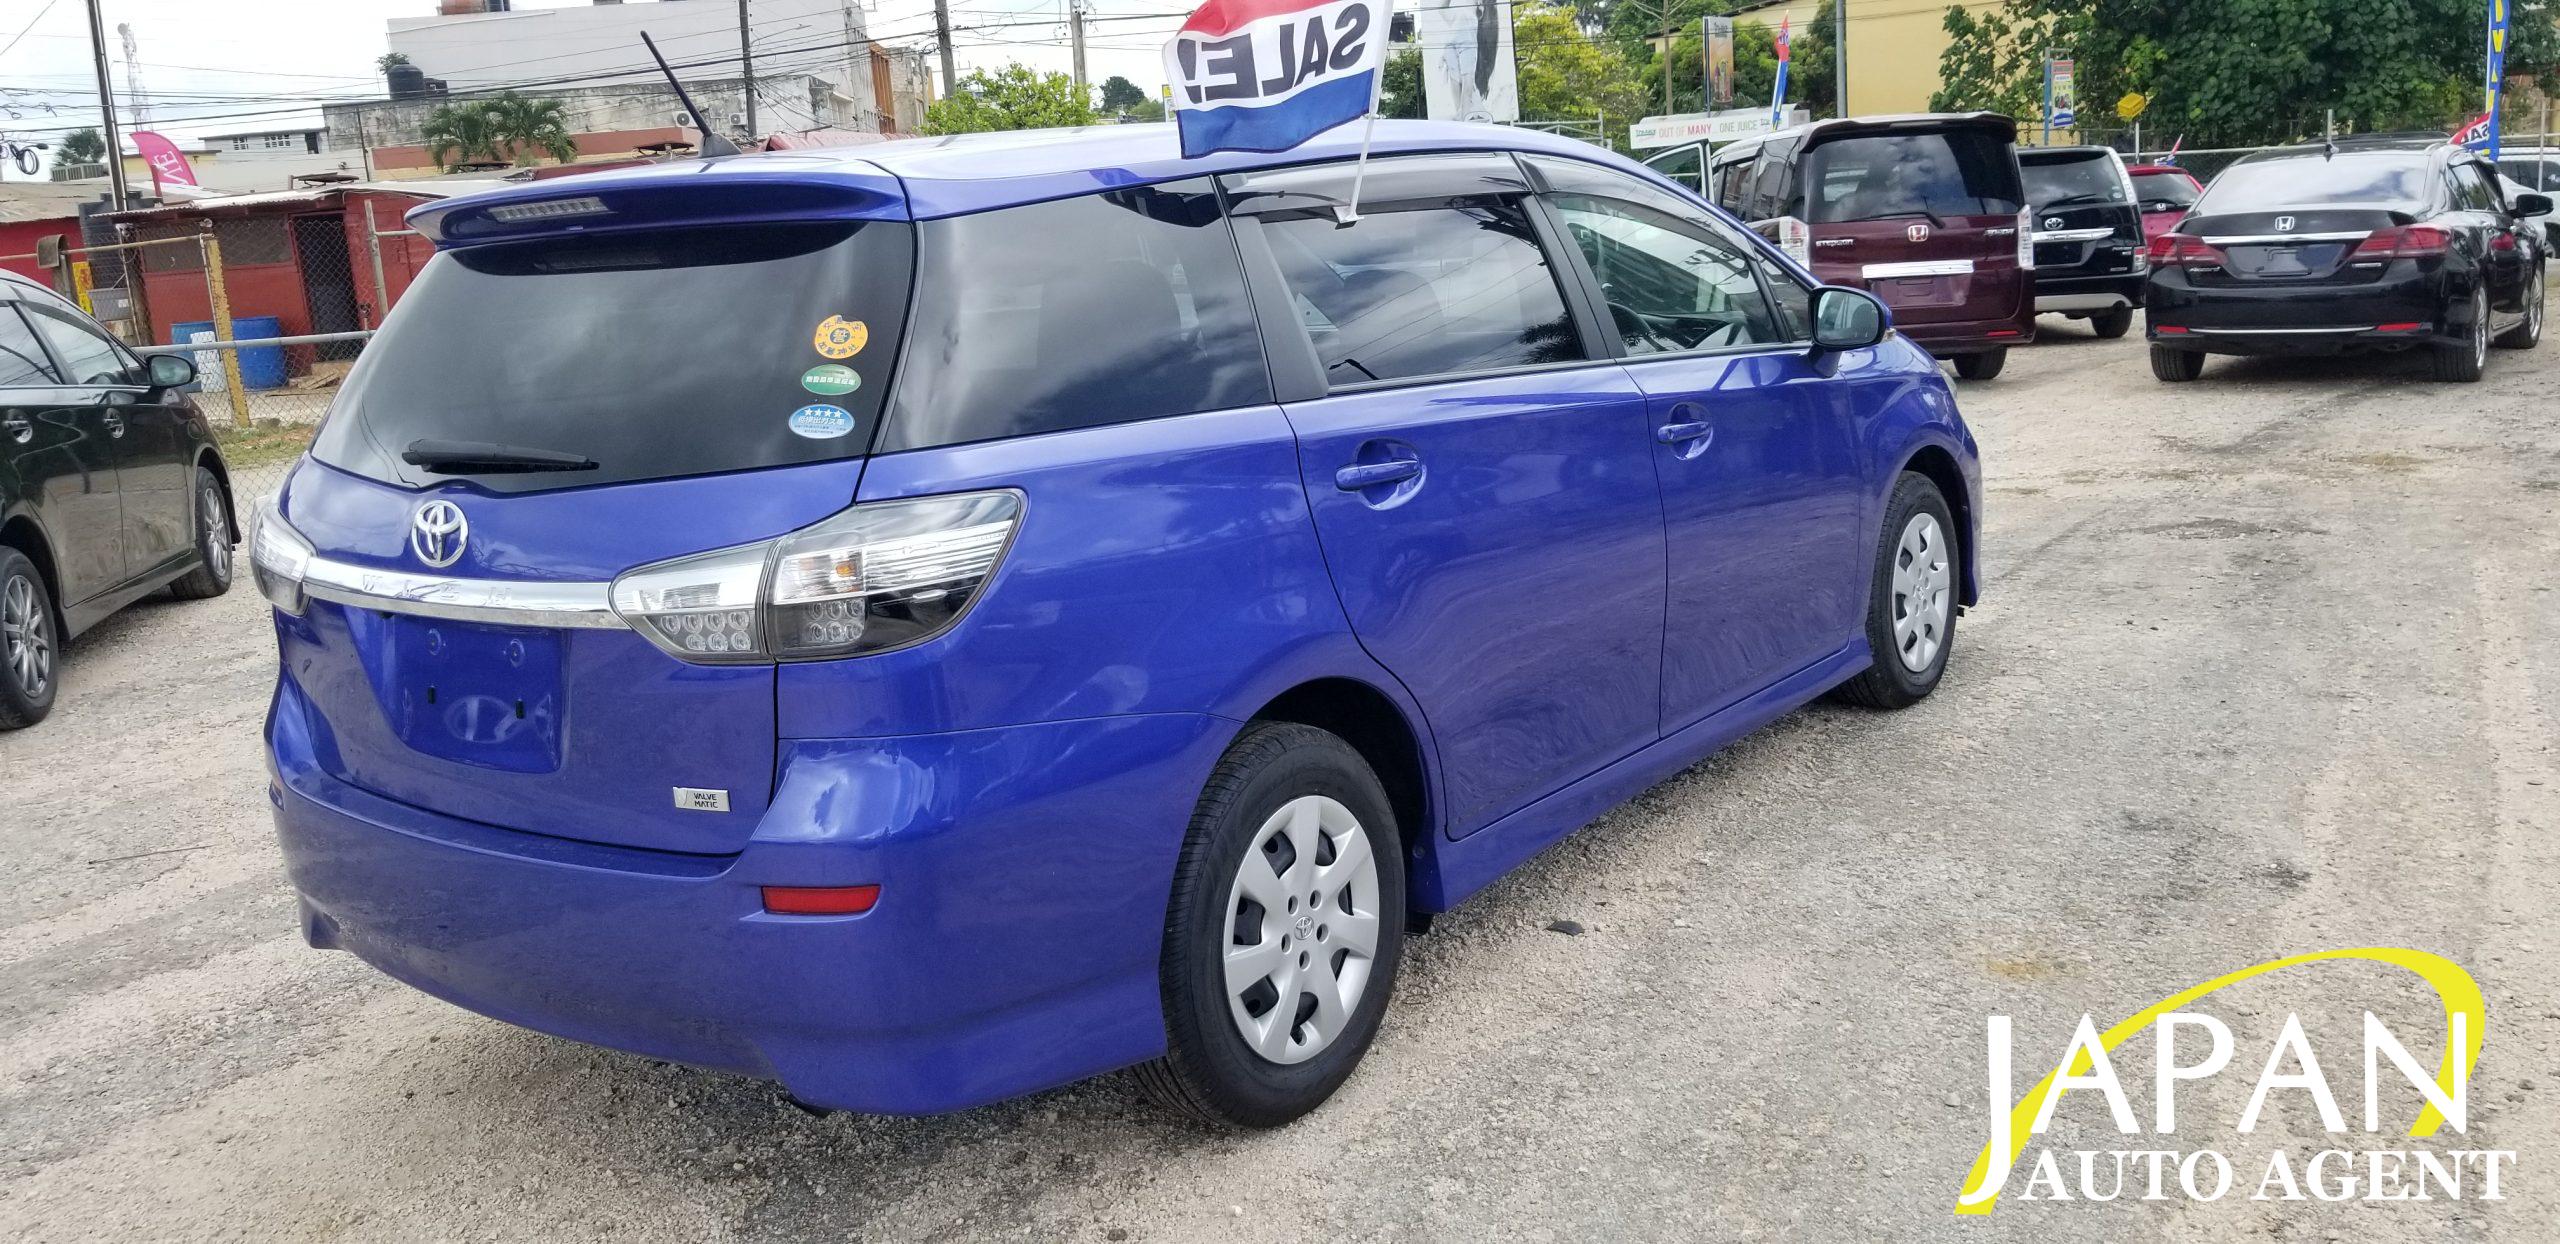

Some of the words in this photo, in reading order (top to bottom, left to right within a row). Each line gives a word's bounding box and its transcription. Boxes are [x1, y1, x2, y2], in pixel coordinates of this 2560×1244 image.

[1687, 123, 1712, 135] MANY
[1720, 121, 1735, 133] ONE
[1737, 119, 1758, 131] JUICE
[693, 792, 718, 801] VALVE
[694, 800, 719, 809] MATIC
